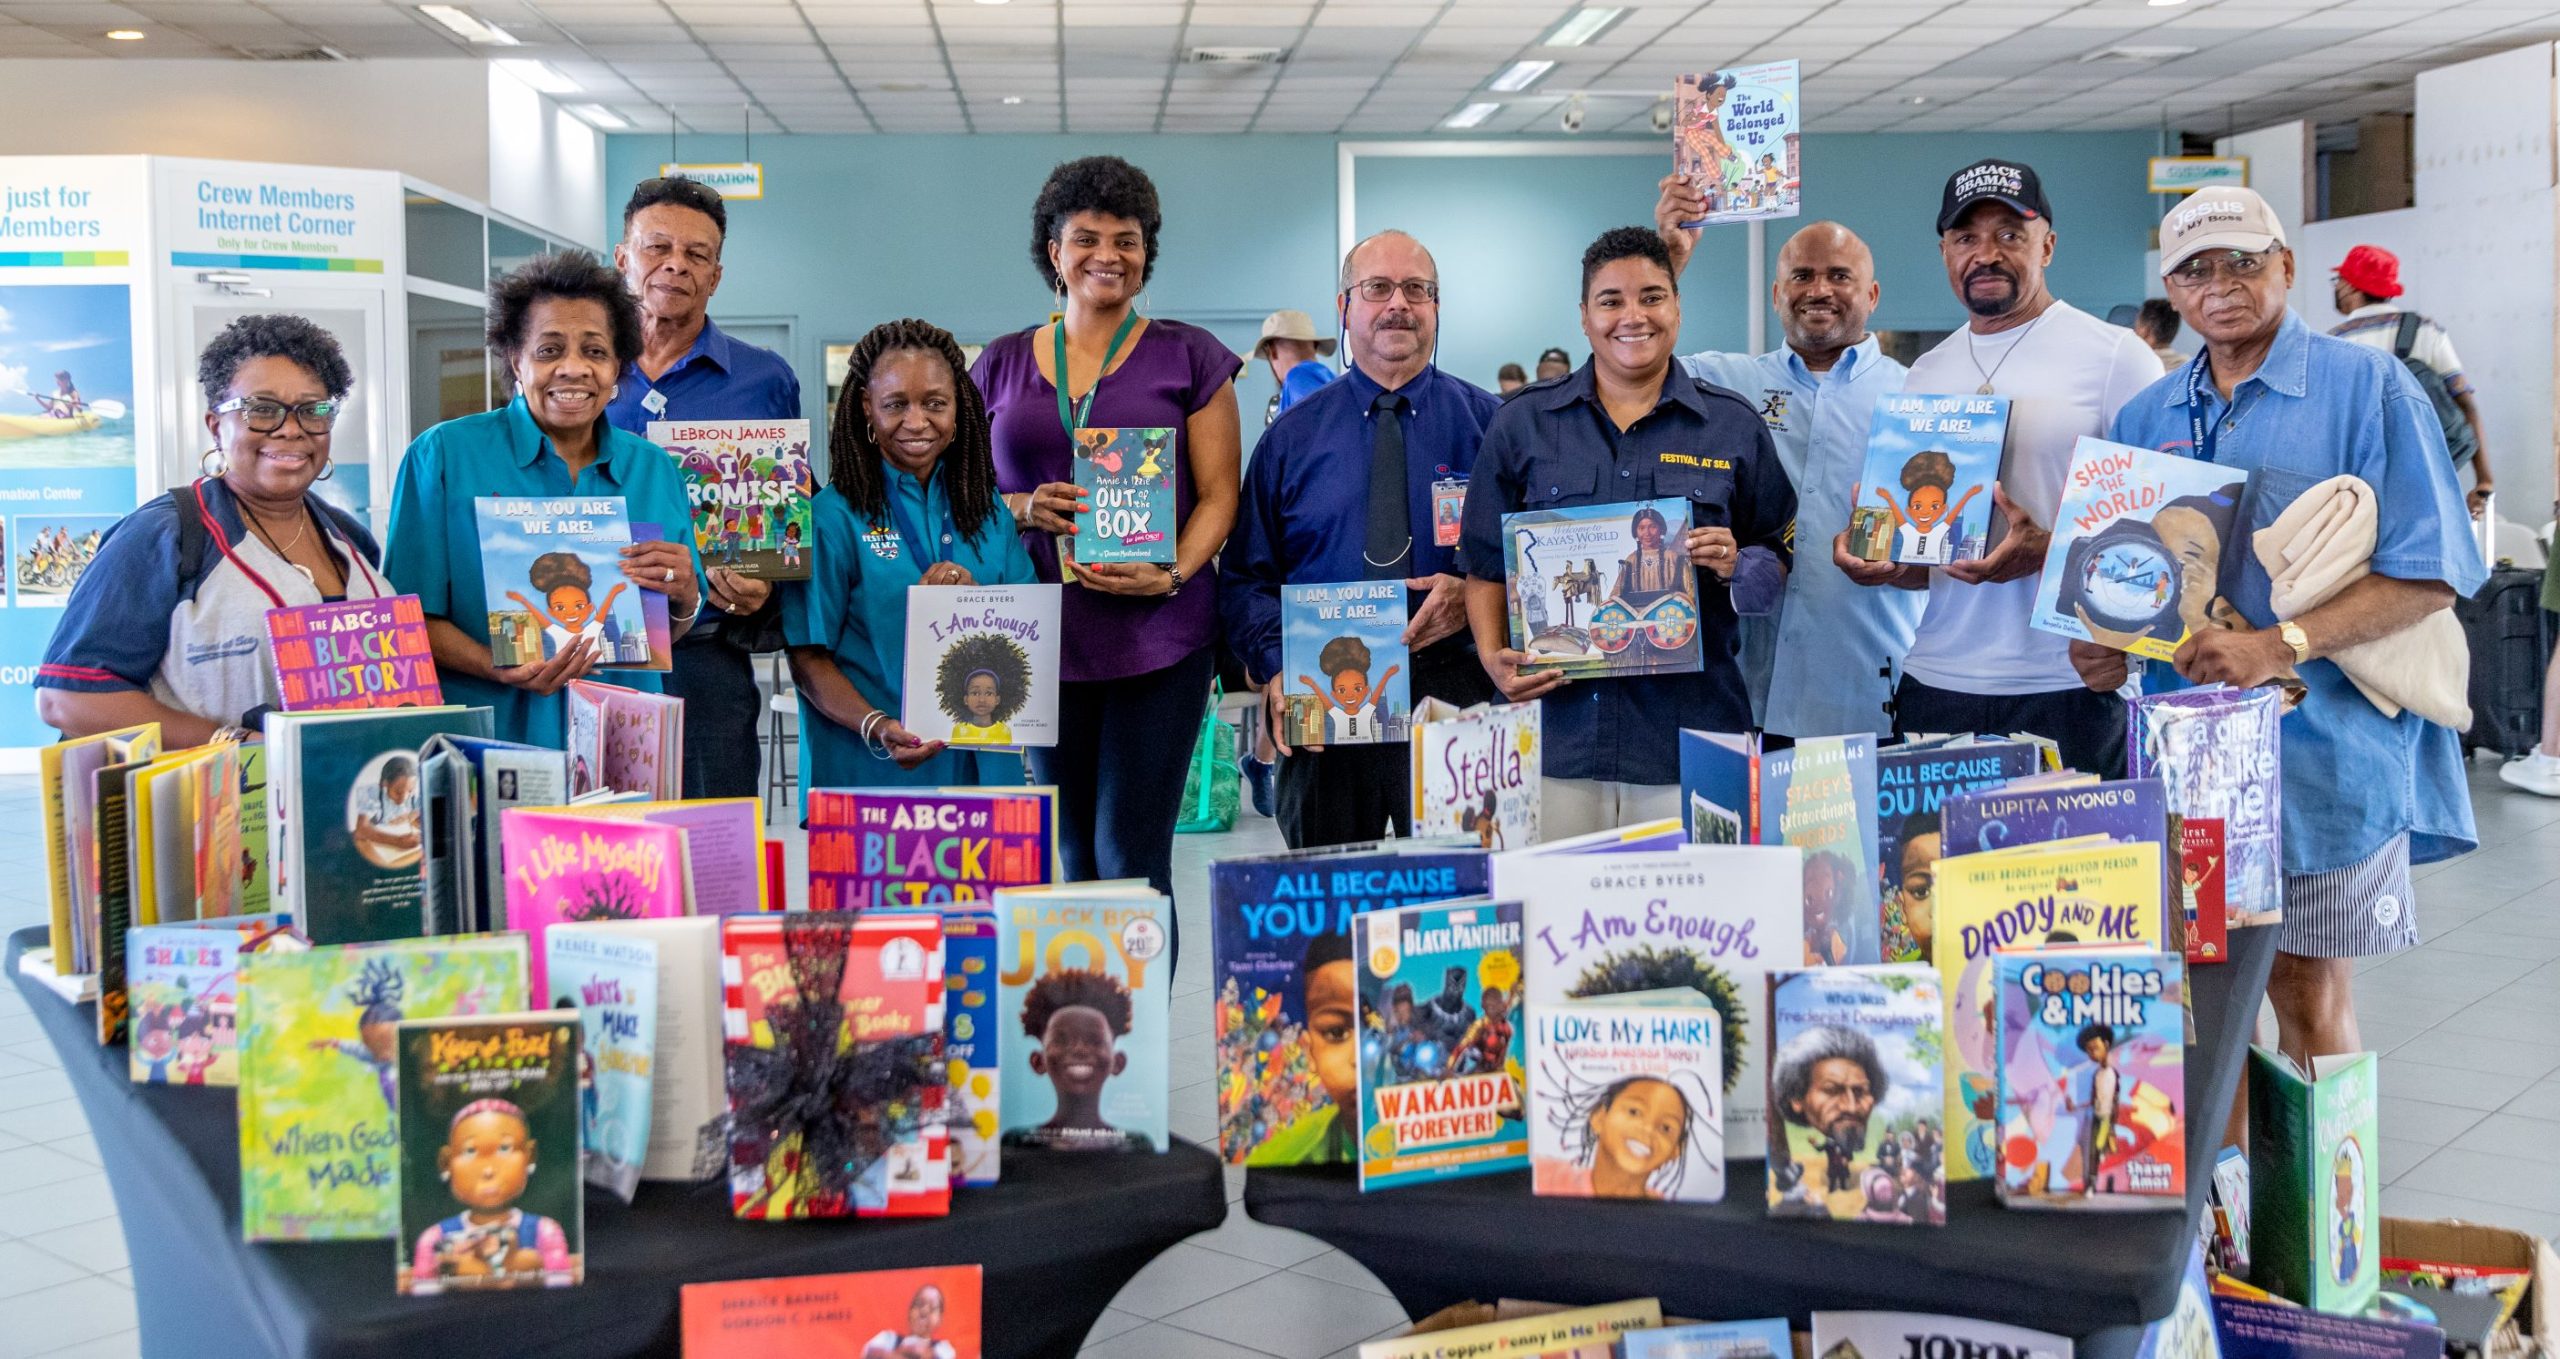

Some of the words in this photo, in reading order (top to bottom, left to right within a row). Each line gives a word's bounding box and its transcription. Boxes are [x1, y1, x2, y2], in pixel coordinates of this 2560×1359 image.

[1732, 99, 1774, 116] World
[1736, 94, 1751, 102] The
[1726, 113, 1784, 131] Belonged
[1736, 134, 1745, 142] to
[1748, 132, 1765, 145] Us
[1955, 165, 2022, 187] BARACK
[1955, 175, 2009, 196] OBAMA
[6, 187, 50, 212] just
[59, 186, 91, 208] for
[197, 181, 252, 203] Crew
[260, 184, 355, 211] Members
[199, 208, 281, 233] Internet
[288, 211, 356, 236] Corner
[217, 237, 241, 252] Only
[245, 238, 258, 250] for
[262, 239, 288, 251] Crew
[291, 240, 339, 253] Members
[1932, 400, 1961, 414] YOU
[737, 426, 786, 441] JAMES
[1909, 419, 1935, 432] WE
[1937, 419, 1972, 433] ARE!
[721, 457, 736, 479] I
[1660, 453, 1699, 467] FESTIVAL
[1701, 458, 1712, 468] AT
[1714, 458, 1731, 470] SEA
[2074, 451, 2134, 488] SHOW
[43, 488, 83, 500] Center
[686, 480, 798, 506] ROMISE
[1096, 475, 1120, 488] Annie
[2096, 473, 2126, 493] THE
[495, 502, 501, 516] I
[543, 501, 577, 516] YOU
[1095, 488, 1137, 508] OUT
[1138, 490, 1149, 500] of
[1134, 500, 1150, 508] the
[2073, 482, 2165, 531] WORLD!
[523, 520, 552, 535] WE
[557, 520, 594, 535] ARE!
[1095, 509, 1152, 538] BOX
[1553, 524, 1590, 535] Welcome
[862, 533, 901, 542] FESTIVAL
[1576, 531, 1619, 543] WORLD
[989, 595, 1015, 603] BYERS
[1297, 590, 1301, 602] I
[1336, 587, 1364, 601] YOU
[309, 620, 328, 632] THE
[330, 610, 378, 634] ABCs
[380, 613, 392, 624] OF
[929, 621, 944, 642] I
[946, 612, 979, 633] Am
[983, 608, 1040, 641] Enough
[1319, 606, 1341, 620] WE
[1347, 604, 1377, 619] ARE!
[315, 629, 399, 667] BLACK
[309, 659, 412, 699] HISTORY
[2193, 722, 2208, 746] a
[1445, 728, 1523, 805] Stella
[1771, 757, 1812, 778] STACEY
[1816, 744, 1865, 767] ABRAMS
[1881, 767, 1915, 787] ALL
[1920, 757, 2001, 783] BECAUSE
[1786, 774, 1852, 807] STACEY'S
[1877, 789, 1915, 818] OU
[861, 806, 887, 824] THE
[891, 803, 965, 831] ABCs
[970, 811, 988, 828] OF
[1981, 798, 2050, 819] LUPITA
[2057, 789, 2136, 811] NYONG'O
[1791, 823, 1846, 849] WORDS
[519, 865, 537, 896] I
[530, 834, 580, 880] Like
[582, 831, 663, 892] Myself!
[862, 832, 991, 880] BLACK
[1272, 873, 1325, 899] ALL
[1331, 867, 1456, 897] BECAUSE
[1590, 875, 1646, 889] GRACE
[1656, 873, 1705, 887] BYERS
[1969, 871, 1997, 884] CHRIS
[2000, 867, 2038, 880] BRIDGES
[2103, 856, 2138, 870] PERSON
[1013, 907, 1094, 927] BLACK
[1240, 901, 1326, 940] YOU
[1960, 894, 2055, 961] DADDY
[2060, 902, 2095, 926] AND
[2097, 904, 2140, 940] ME
[1403, 929, 1451, 957] BLACK
[1452, 921, 1521, 950] PANTHER
[1537, 925, 1568, 966] I
[1571, 908, 1637, 949] Am
[1644, 899, 1759, 958] Enough
[145, 946, 222, 967] SHAPES
[602, 942, 653, 962] WATSON
[1000, 929, 1149, 989] JOY
[2022, 961, 2163, 996] Cookies
[1777, 1007, 1848, 1024] Frederick
[2042, 994, 2067, 1025] &
[2072, 993, 2145, 1026] Milk
[1539, 1016, 1545, 1046] I
[1554, 1015, 1601, 1045] LOVE
[1652, 1016, 1711, 1047] HAIR!
[1378, 1082, 1513, 1123] WAKANDA
[265, 1122, 344, 1156] When
[1399, 1112, 1493, 1143] FOREVER!
[308, 1154, 391, 1190] Made
[2127, 1160, 2172, 1177] Shawn
[2130, 1175, 2170, 1190] Amos
[1435, 1342, 1494, 1359] Copper
[1499, 1333, 1547, 1351] Penny
[1552, 1329, 1566, 1341] in
[1598, 1315, 1646, 1334] House
